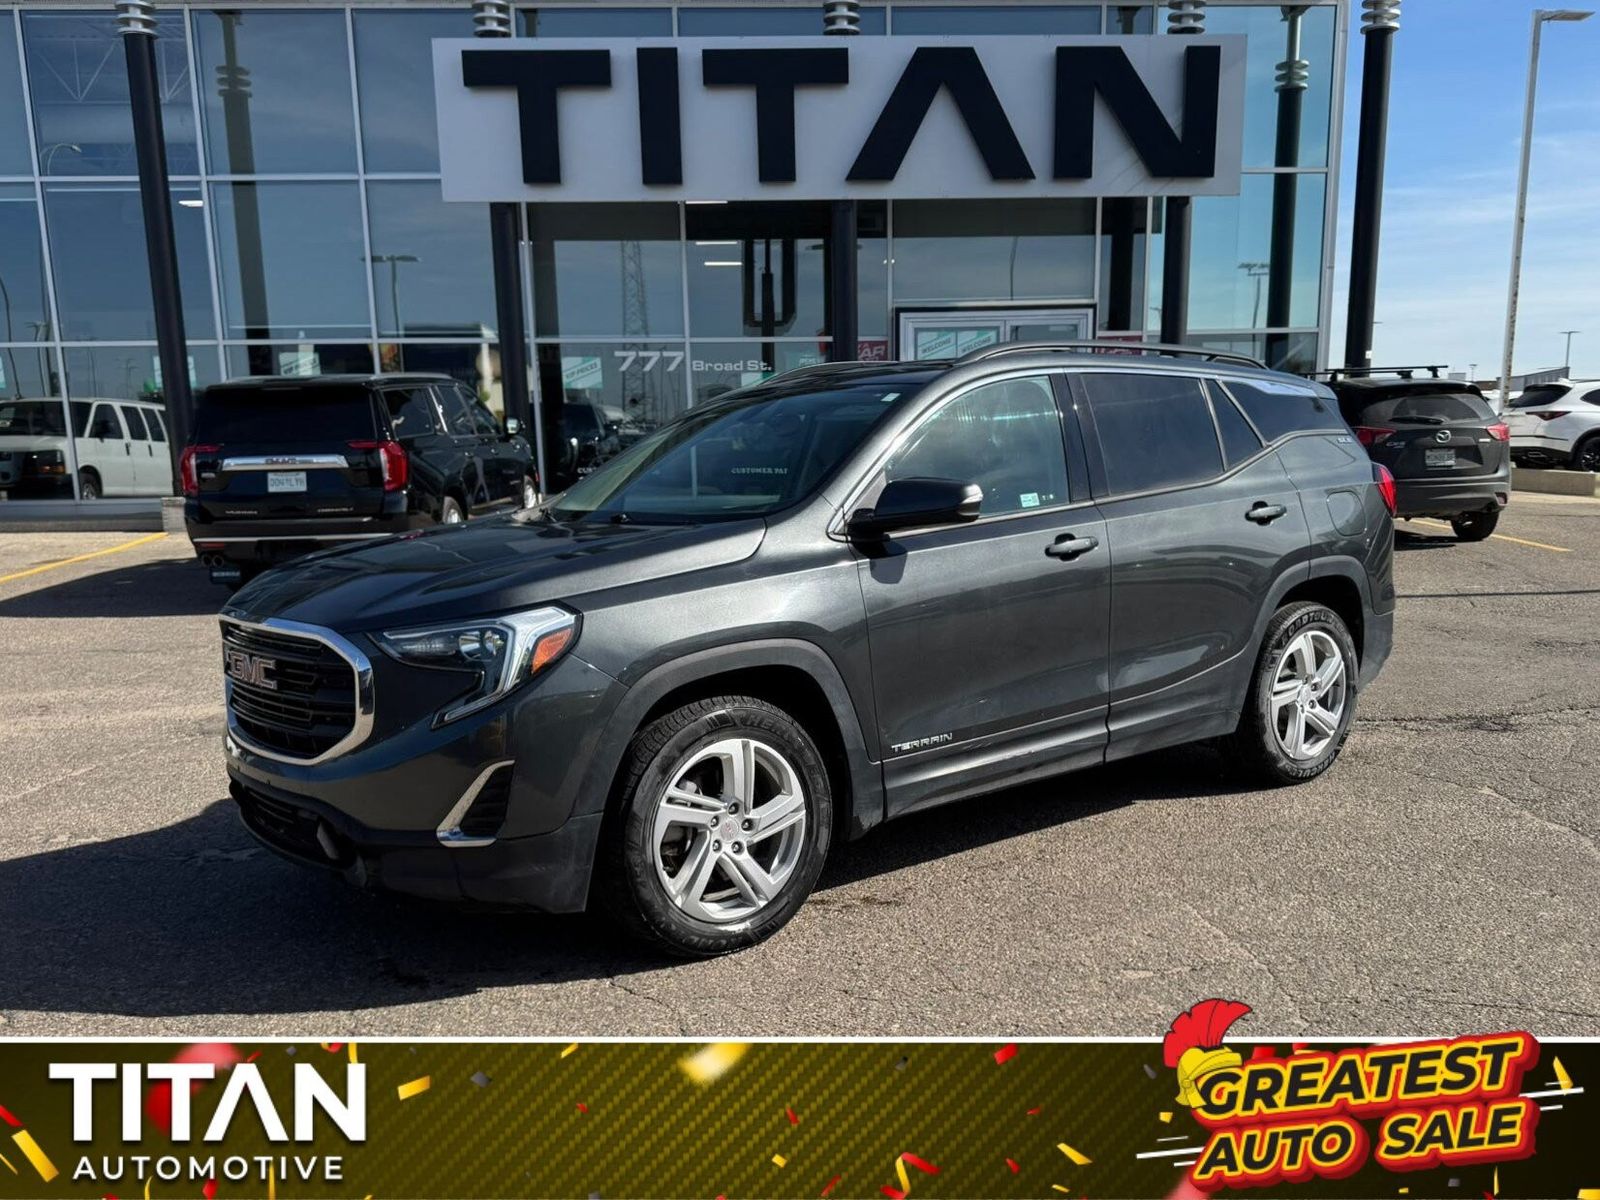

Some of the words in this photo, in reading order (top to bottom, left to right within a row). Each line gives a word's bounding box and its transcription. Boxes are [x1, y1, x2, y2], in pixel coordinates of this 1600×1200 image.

[461, 45, 1221, 185] TITAN
[613, 351, 684, 372] 777
[692, 360, 743, 372] Broad
[747, 360, 772, 372] St.
[226, 650, 278, 690] GMC
[891, 732, 953, 753] TERRAIN
